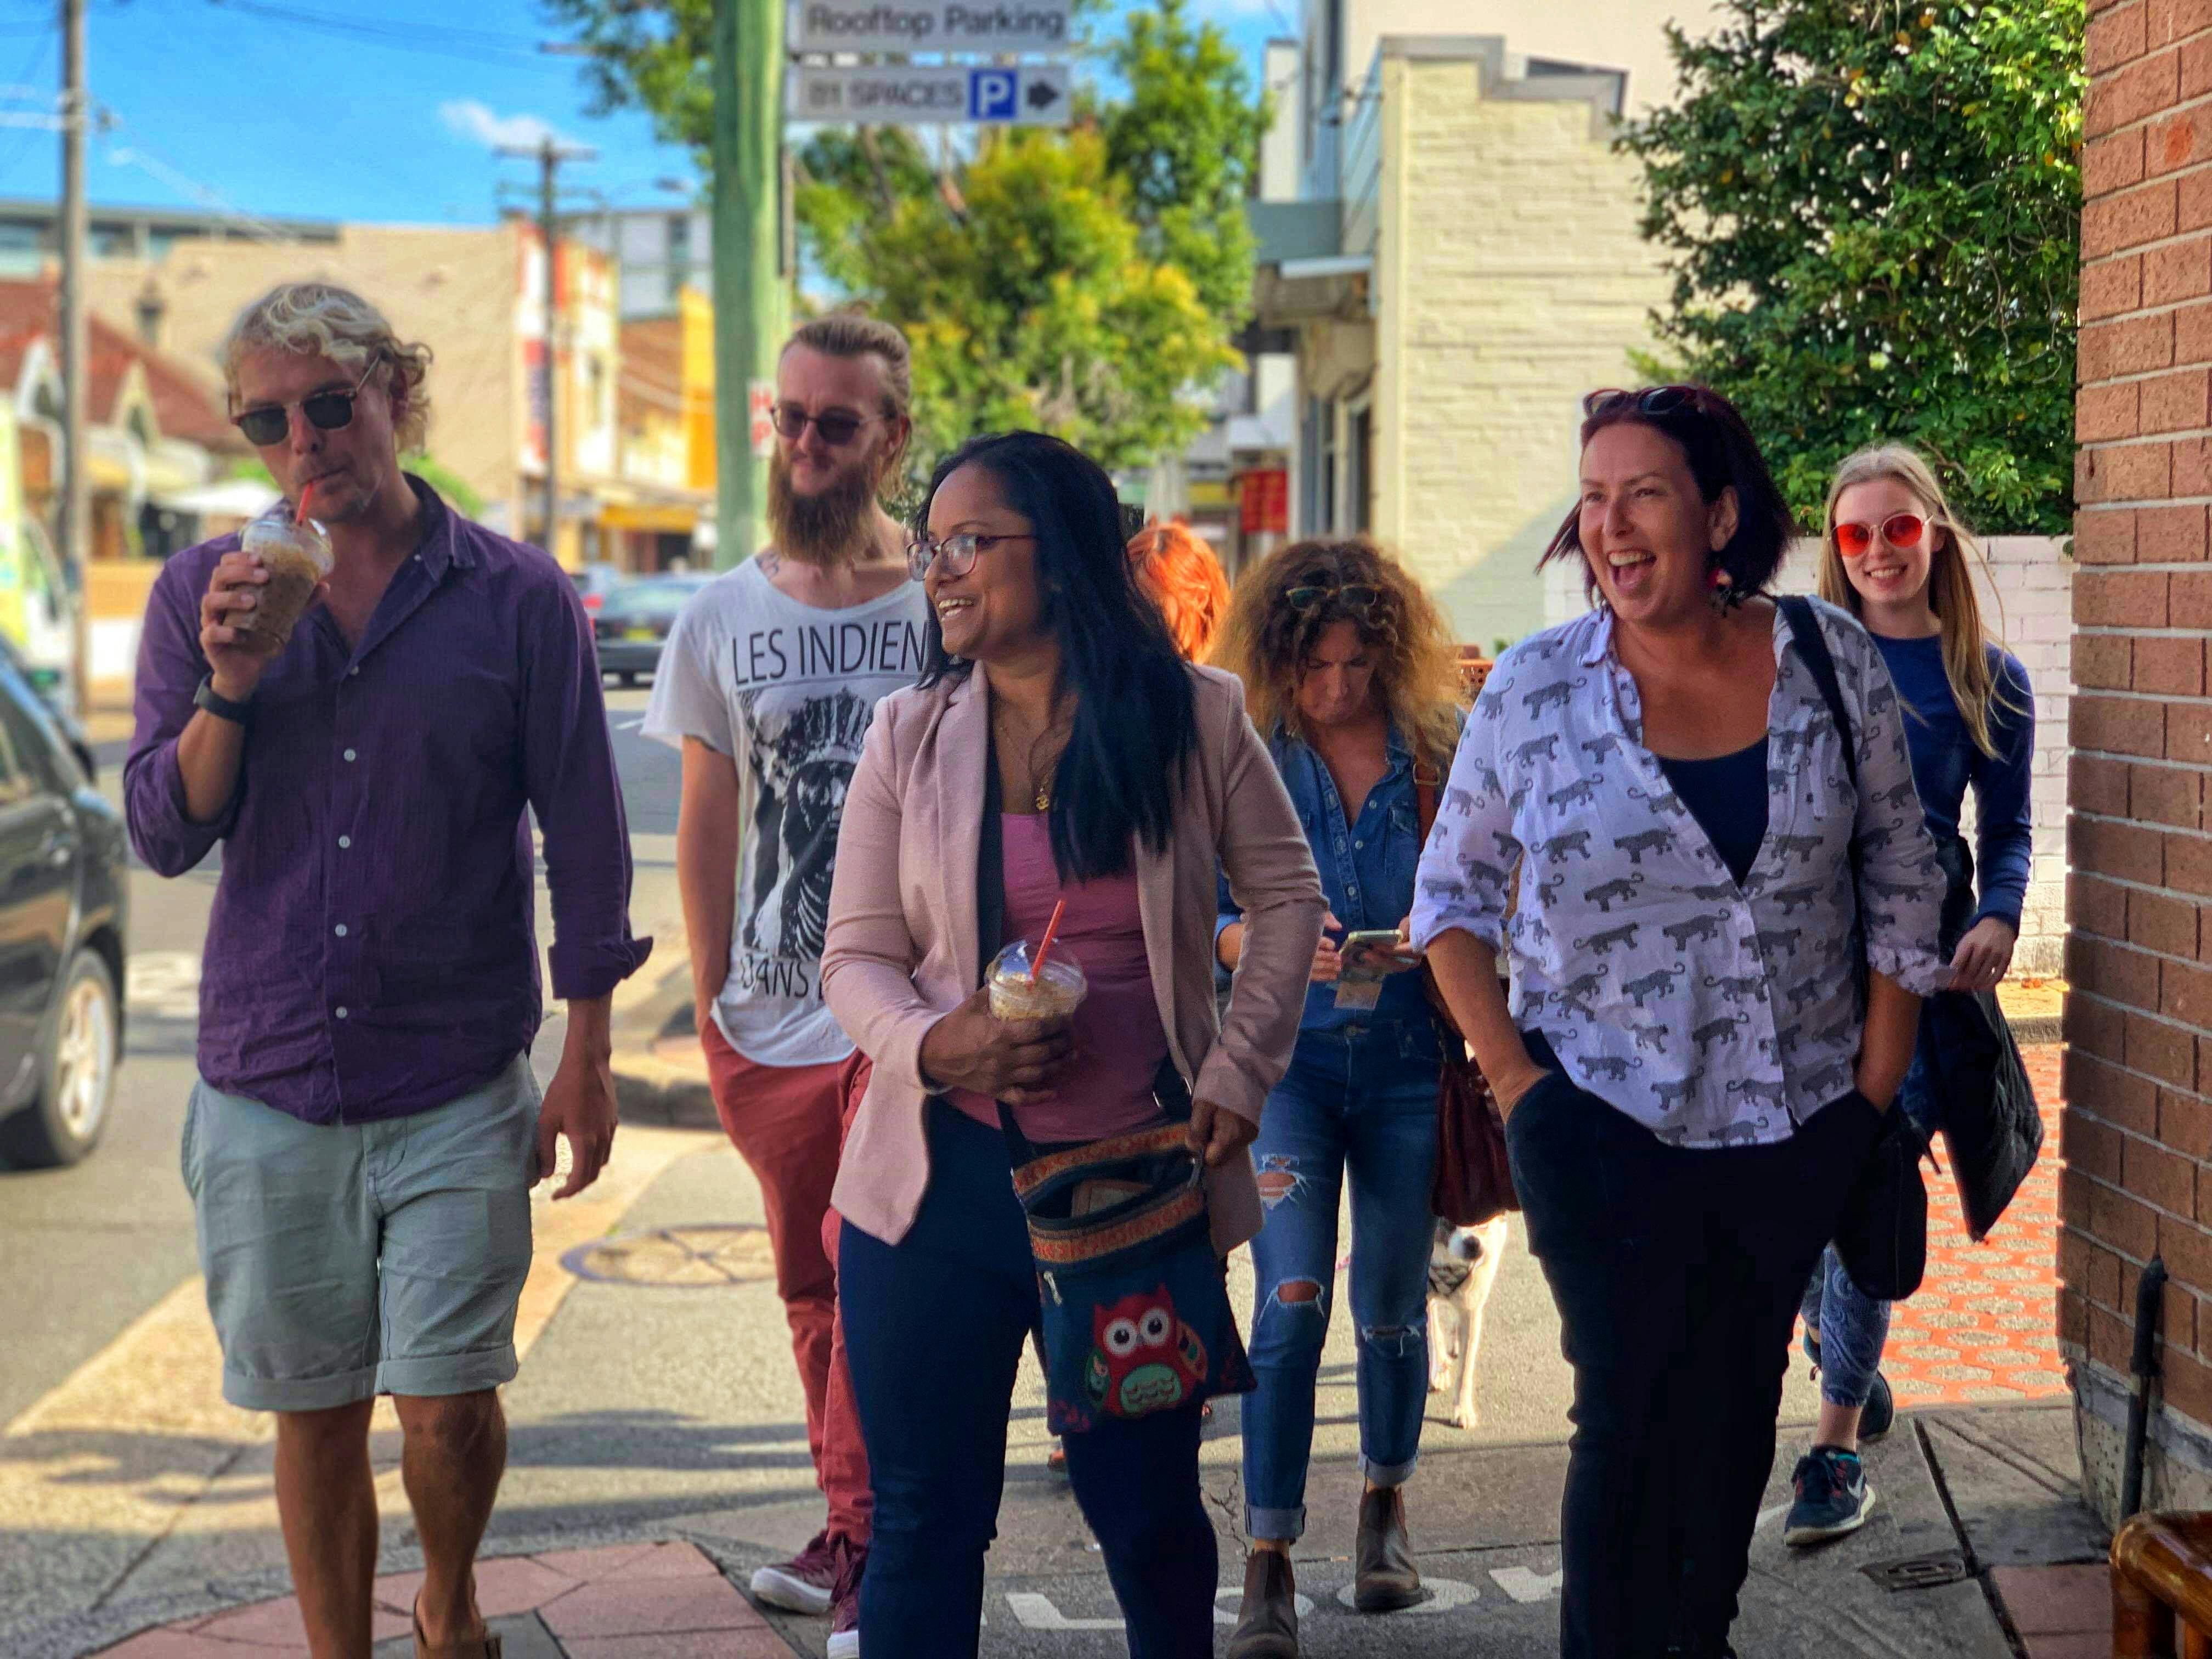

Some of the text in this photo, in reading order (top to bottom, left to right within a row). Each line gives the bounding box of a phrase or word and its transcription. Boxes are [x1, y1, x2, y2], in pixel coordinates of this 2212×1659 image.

[807, 3, 1065, 41] Rooftop Parking
[849, 78, 964, 107] SPACES
[978, 76, 1011, 117] P
[732, 627, 787, 685] LES
[740, 952, 809, 998] DANS
